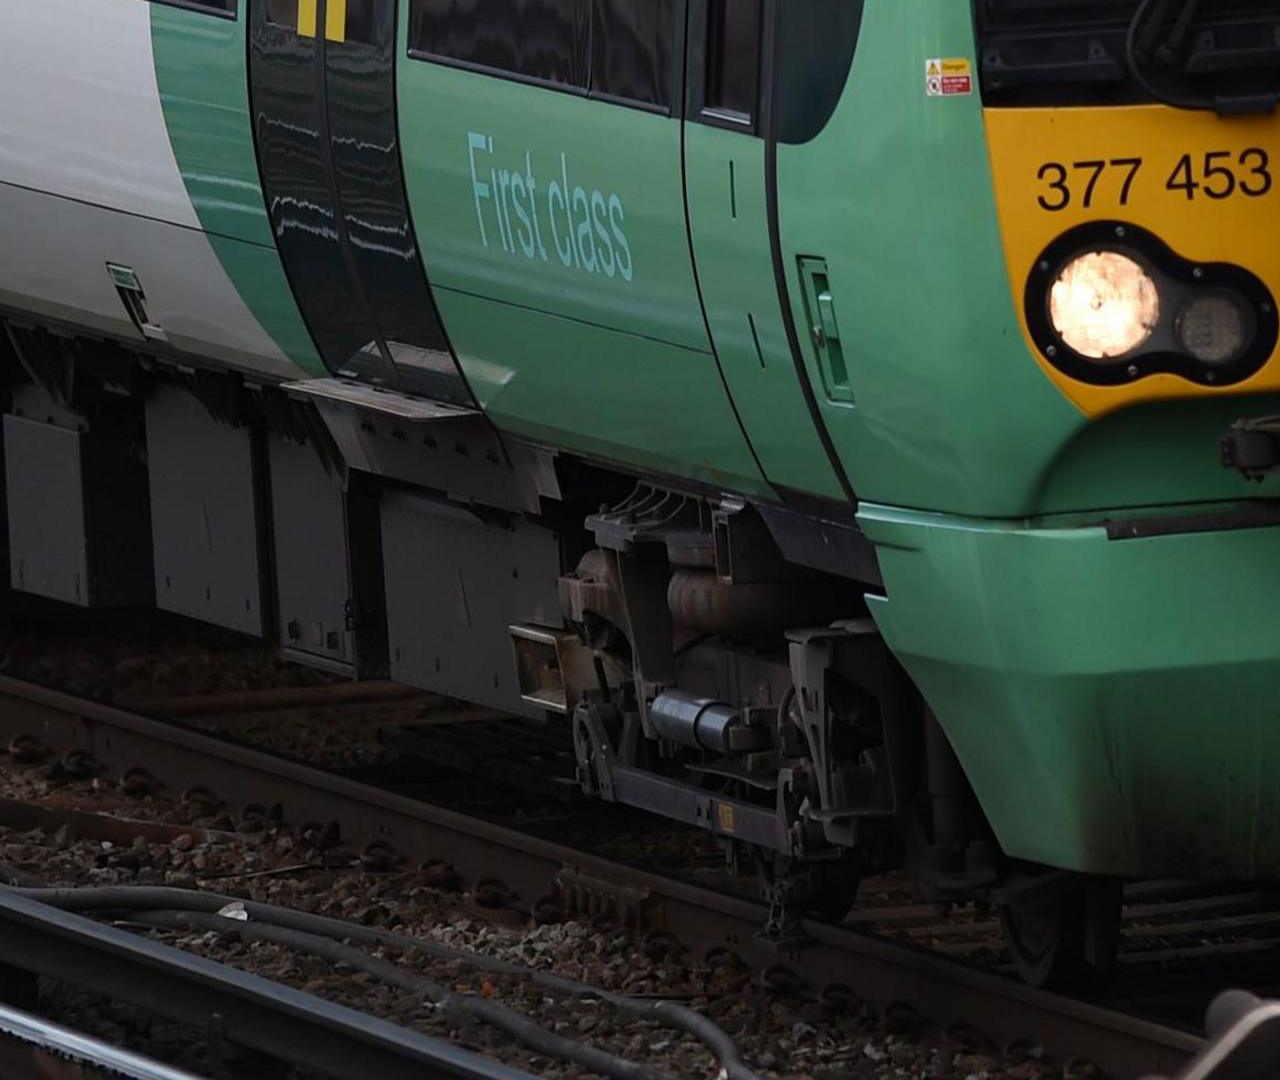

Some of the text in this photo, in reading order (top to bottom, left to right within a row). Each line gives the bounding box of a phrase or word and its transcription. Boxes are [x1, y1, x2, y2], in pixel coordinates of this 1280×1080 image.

[468, 132, 632, 281] First class
[1037, 147, 1272, 212] 377 453
